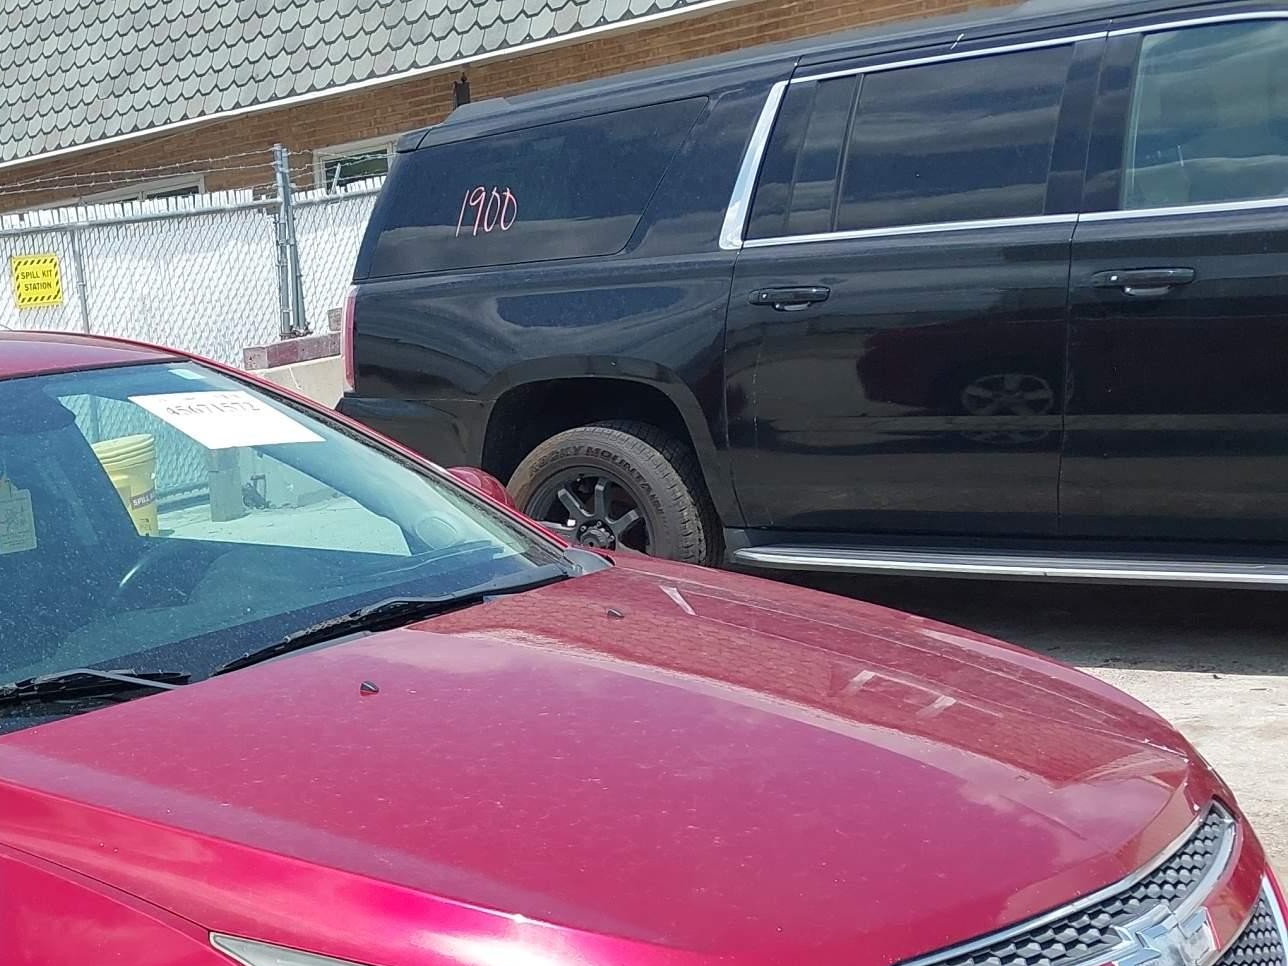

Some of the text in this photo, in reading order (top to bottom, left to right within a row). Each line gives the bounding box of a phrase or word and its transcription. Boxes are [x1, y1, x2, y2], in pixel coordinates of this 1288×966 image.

[455, 186, 518, 237] 1900
[20, 269, 53, 280] SPILL KIT
[24, 281, 52, 291] STATION
